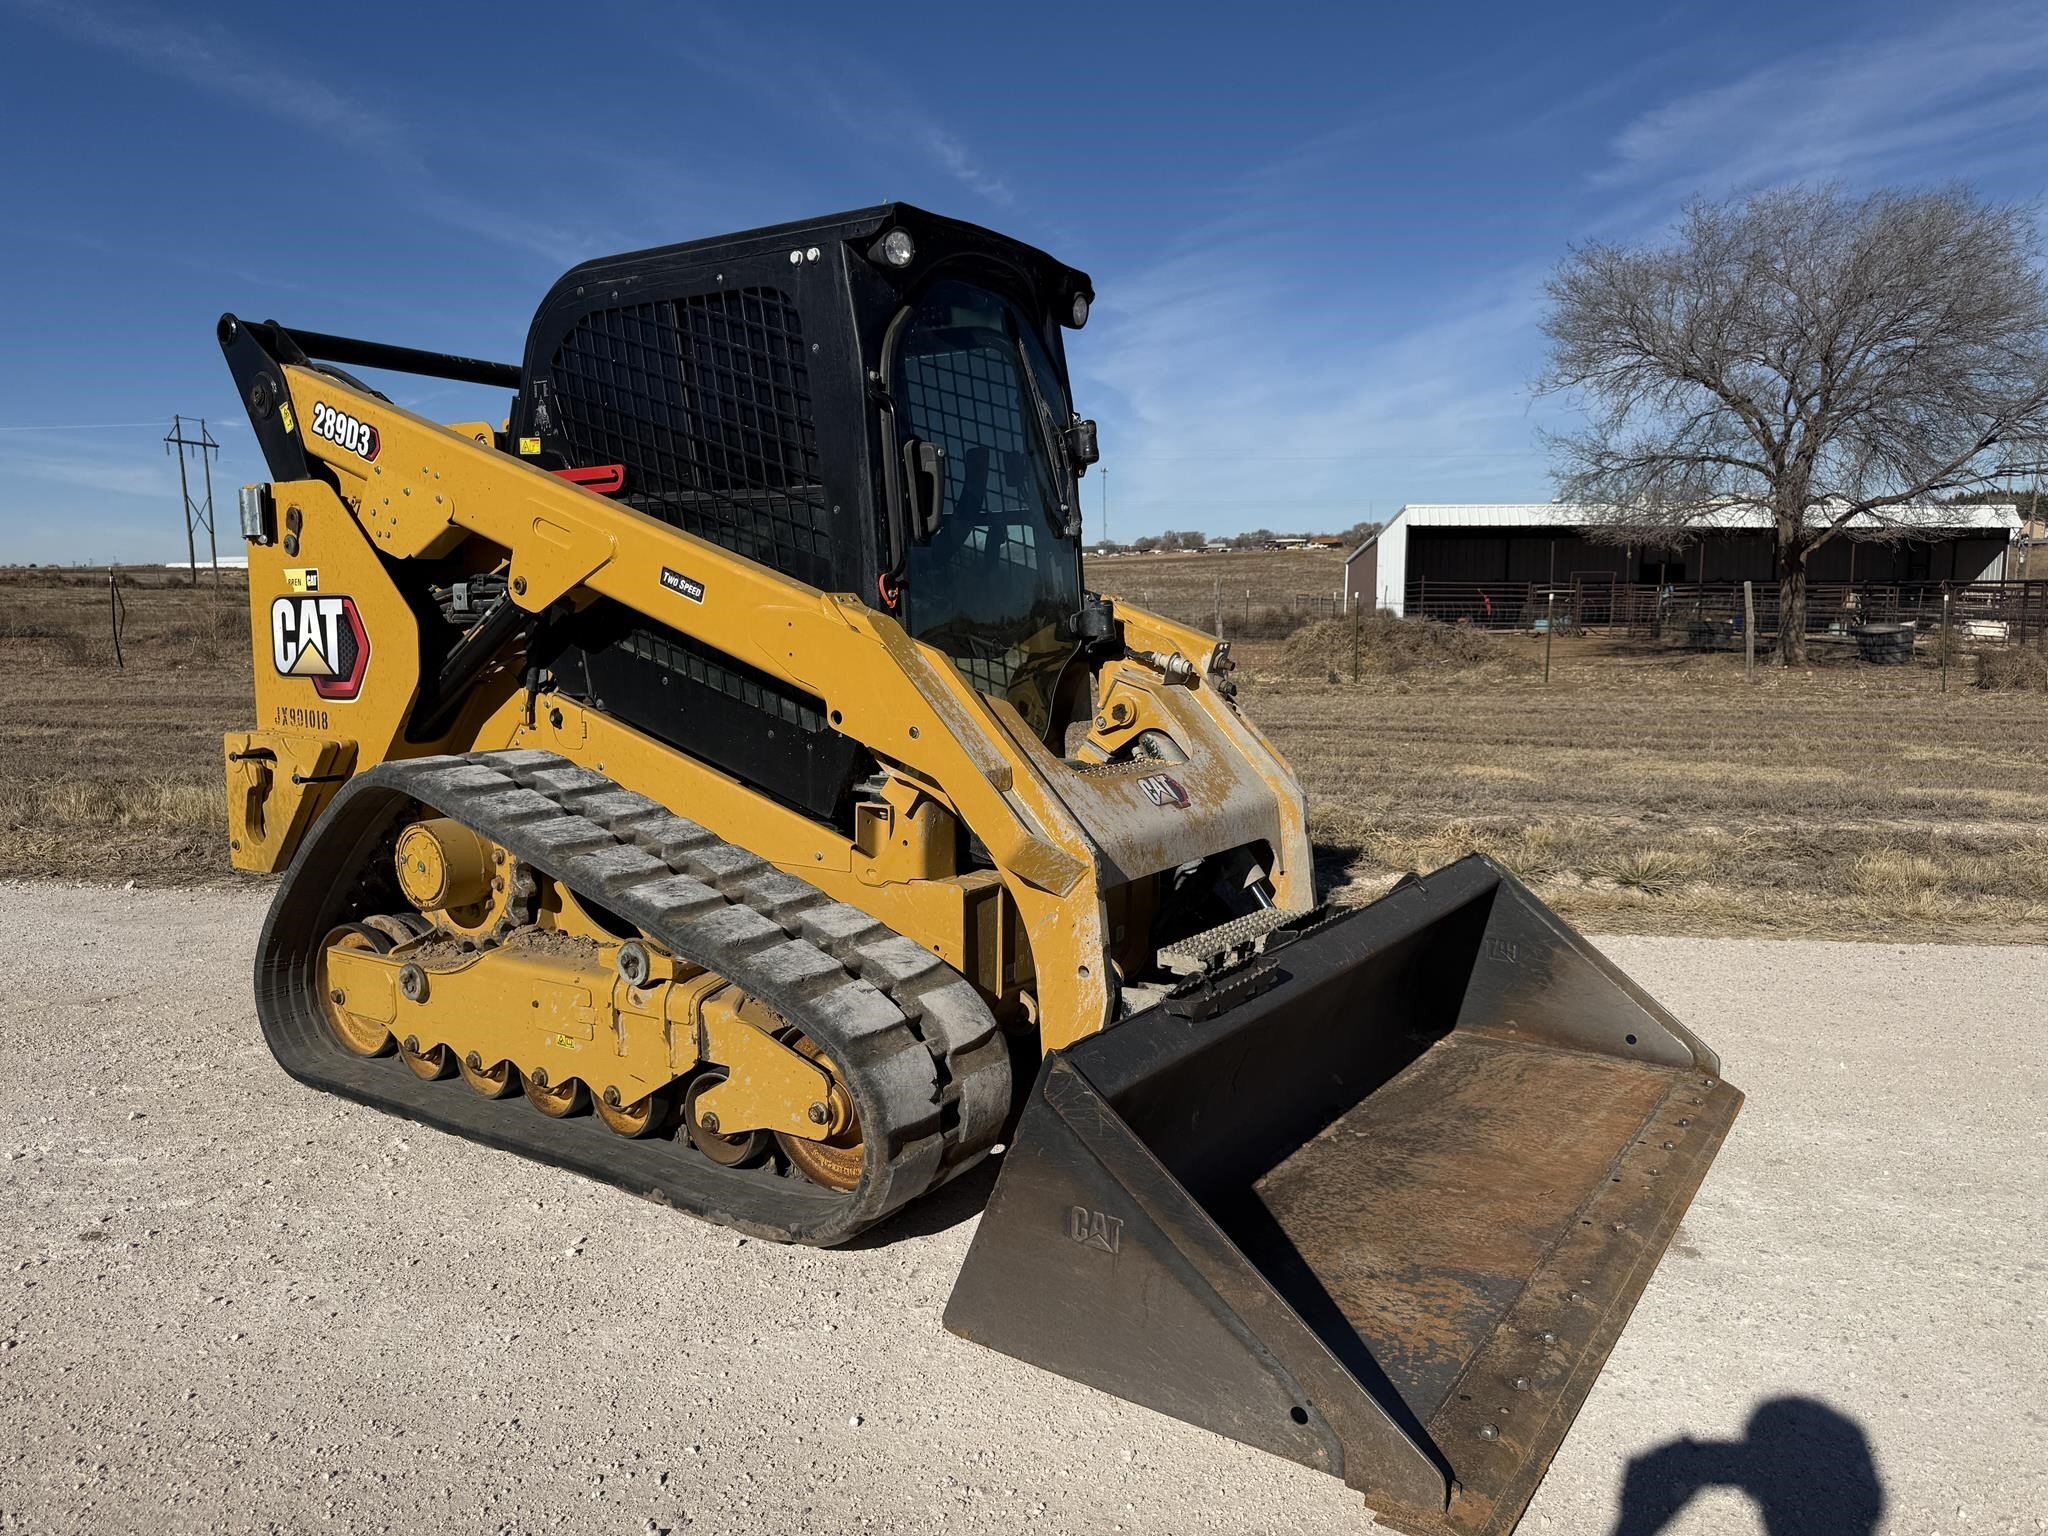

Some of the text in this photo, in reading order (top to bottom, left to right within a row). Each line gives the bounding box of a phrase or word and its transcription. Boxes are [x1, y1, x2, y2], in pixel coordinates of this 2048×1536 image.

[312, 402, 371, 457] 289D3
[272, 598, 343, 675] CAT
[1138, 775, 1180, 806] CAT
[1071, 1205, 1124, 1254] CAT
